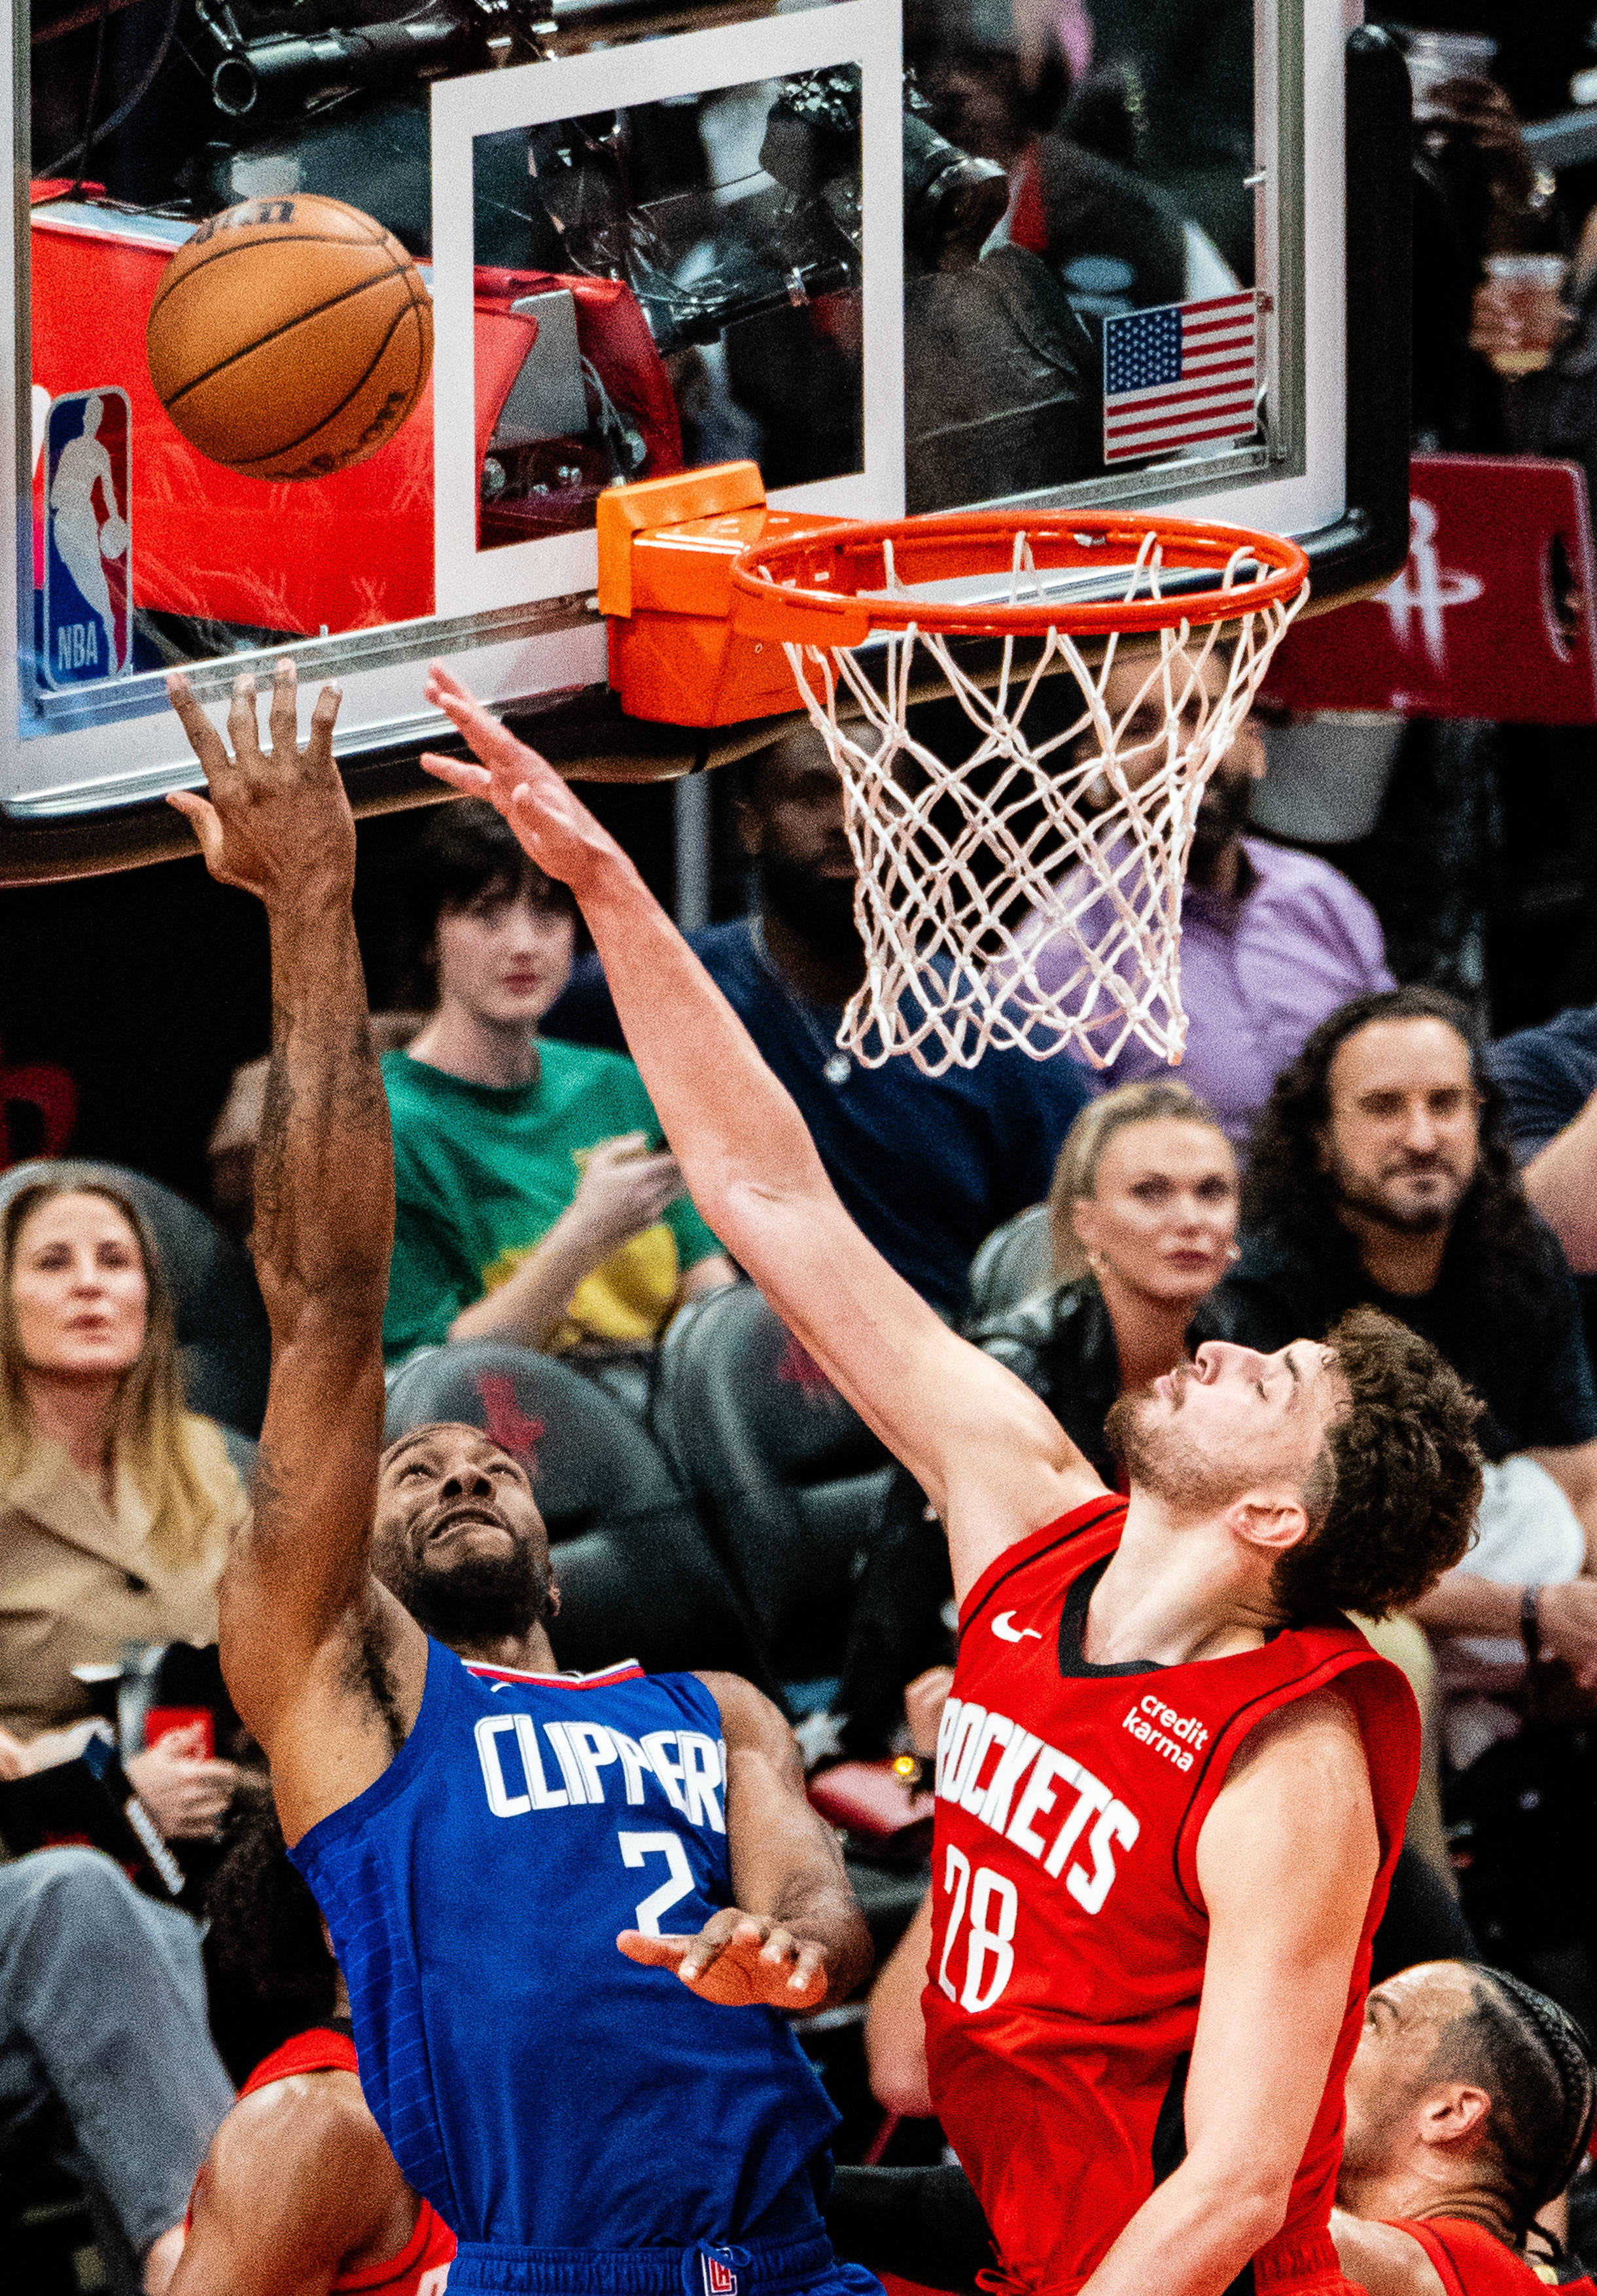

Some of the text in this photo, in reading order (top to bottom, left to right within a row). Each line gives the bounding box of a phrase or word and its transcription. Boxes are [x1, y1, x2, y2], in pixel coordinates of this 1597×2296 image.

[57, 621, 98, 670] NBA
[1122, 1706, 1195, 1772] karma
[1140, 1695, 1209, 1750] credit
[474, 1713, 727, 1834] CLIPPER
[618, 1831, 696, 1939] 2
[938, 1843, 1018, 2014] 28
